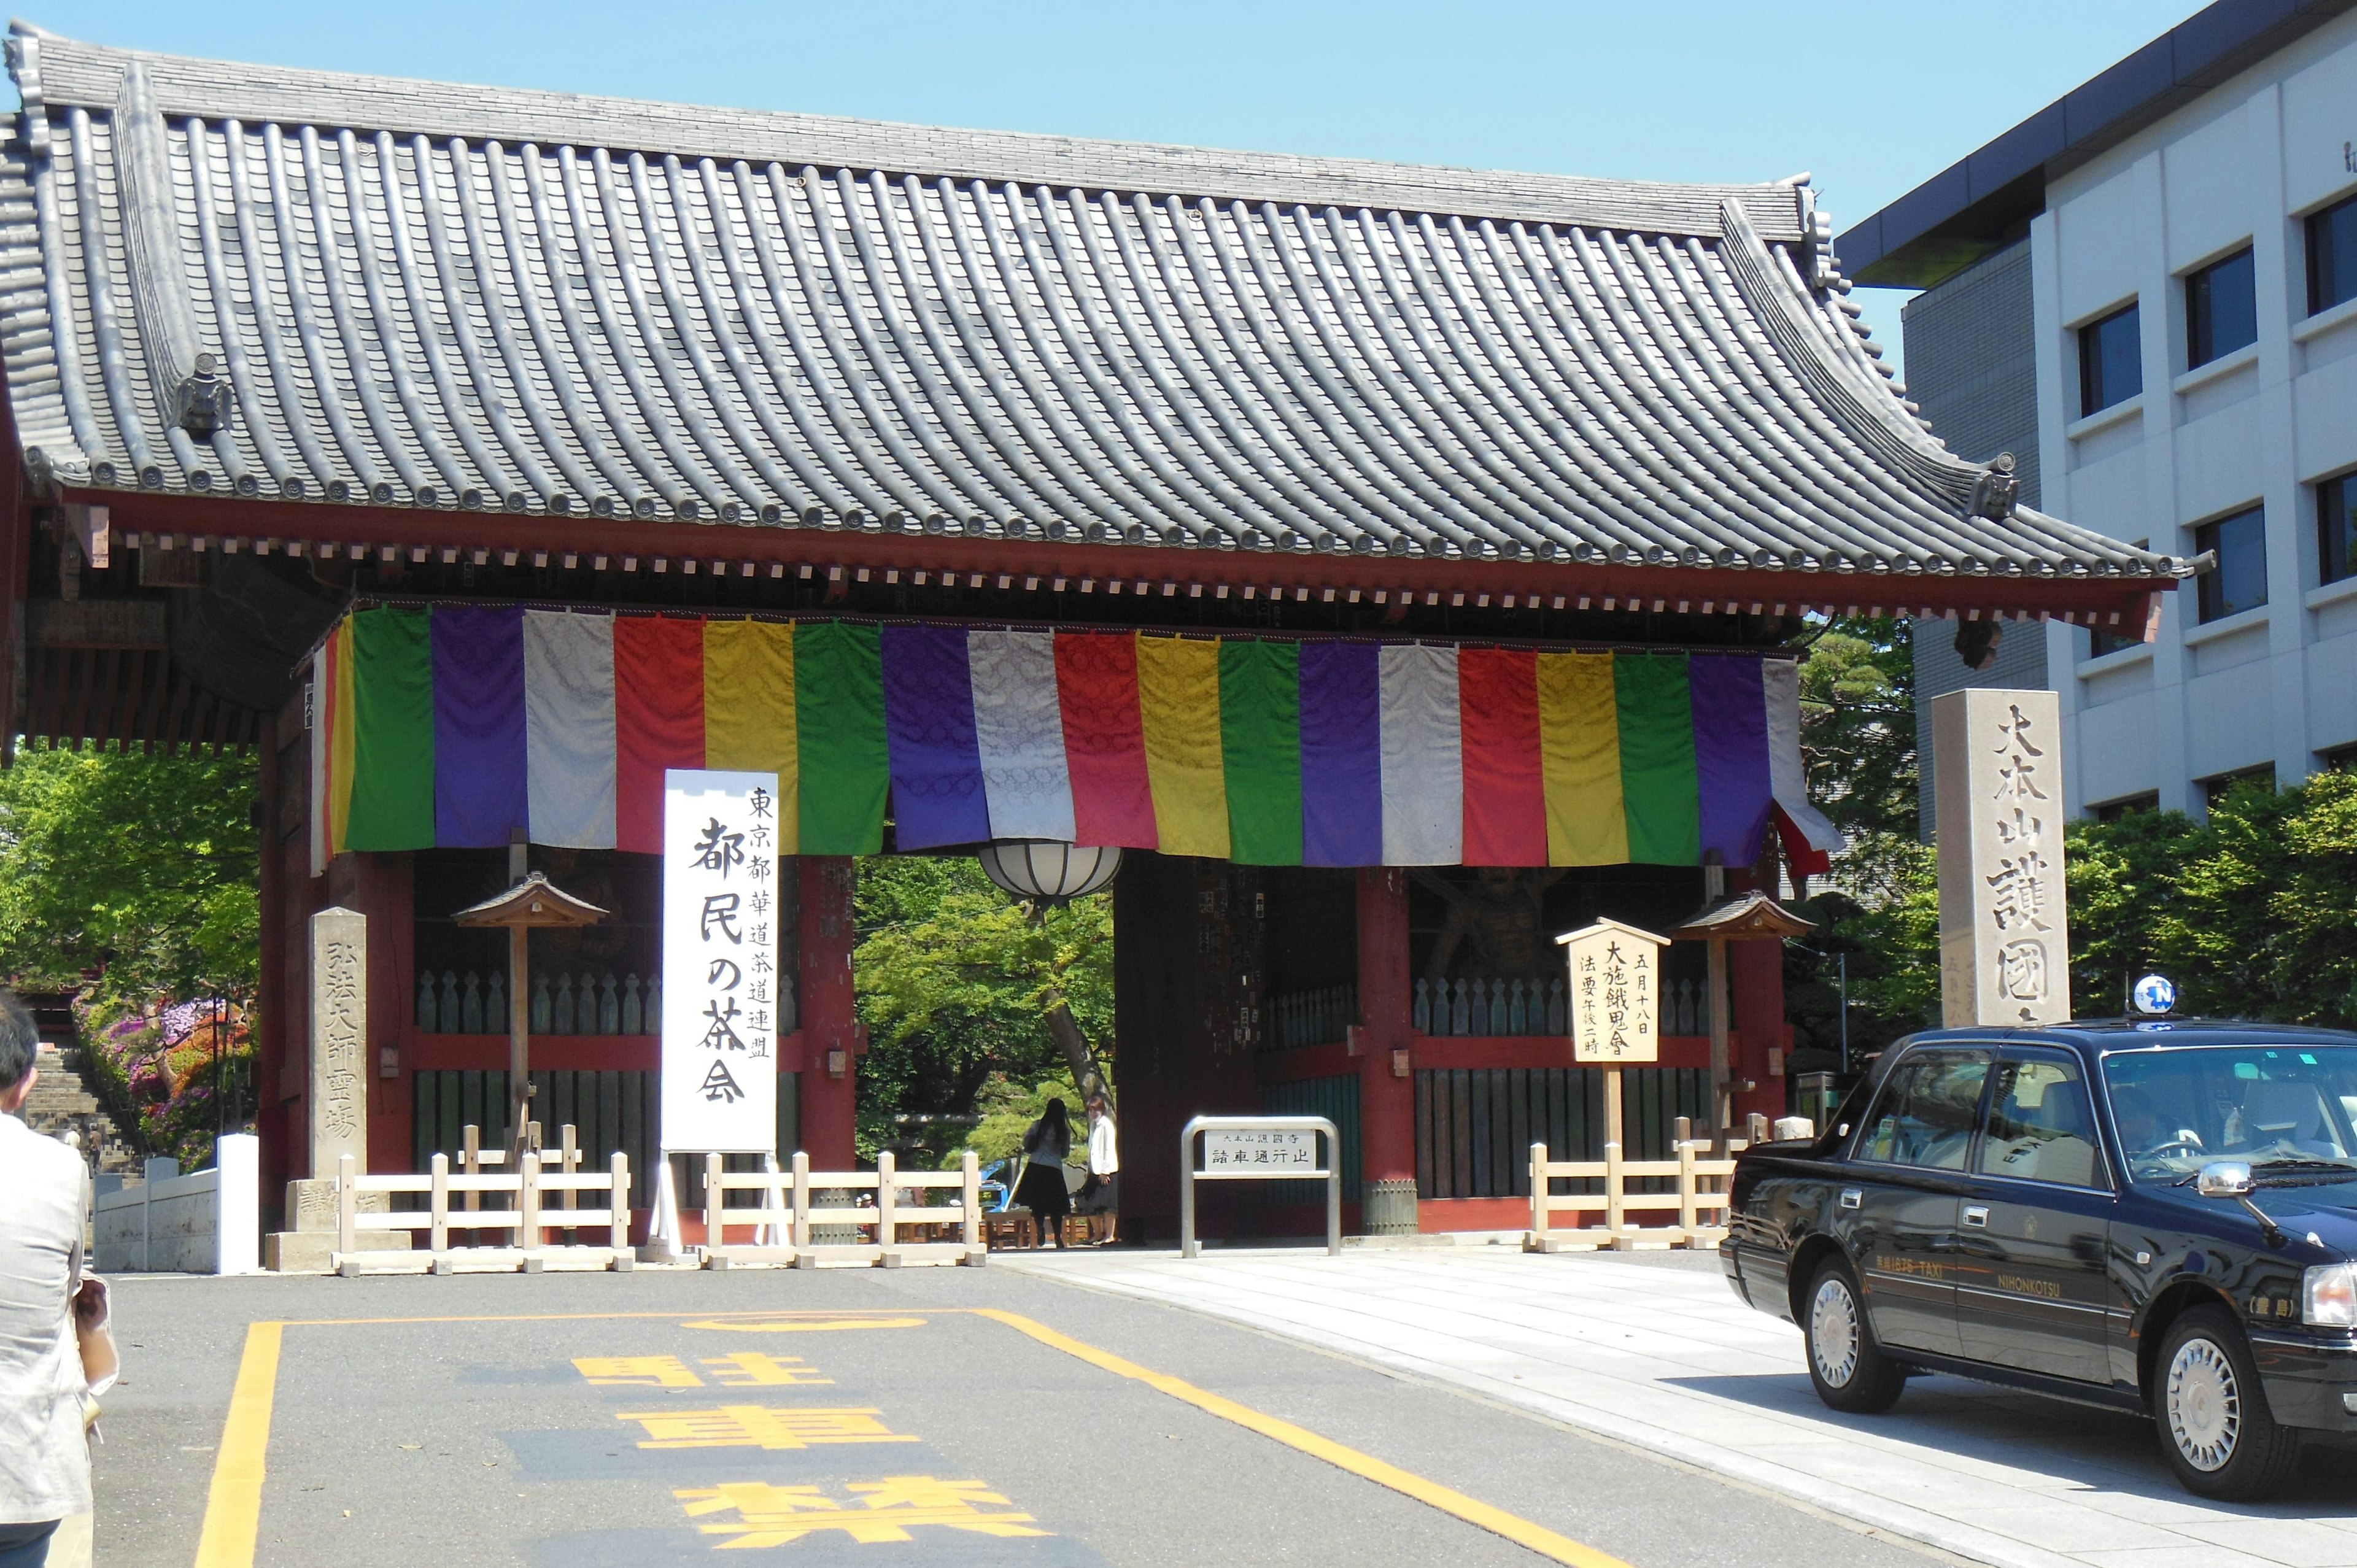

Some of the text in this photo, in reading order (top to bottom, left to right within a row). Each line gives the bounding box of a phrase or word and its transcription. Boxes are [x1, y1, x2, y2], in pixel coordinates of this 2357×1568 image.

[688, 817, 746, 1104] 都民の茶会
[746, 787, 773, 1059] 東京都華道茶道連盟
[1580, 955, 1599, 1054] 法要午後二時
[1634, 954, 1651, 1035] 五月十八日
[1212, 1149, 1309, 1164] 諸車通行止
[1919, 1261, 1943, 1278] TAXI
[1999, 1275, 2061, 1297] NIHONKOTSU
